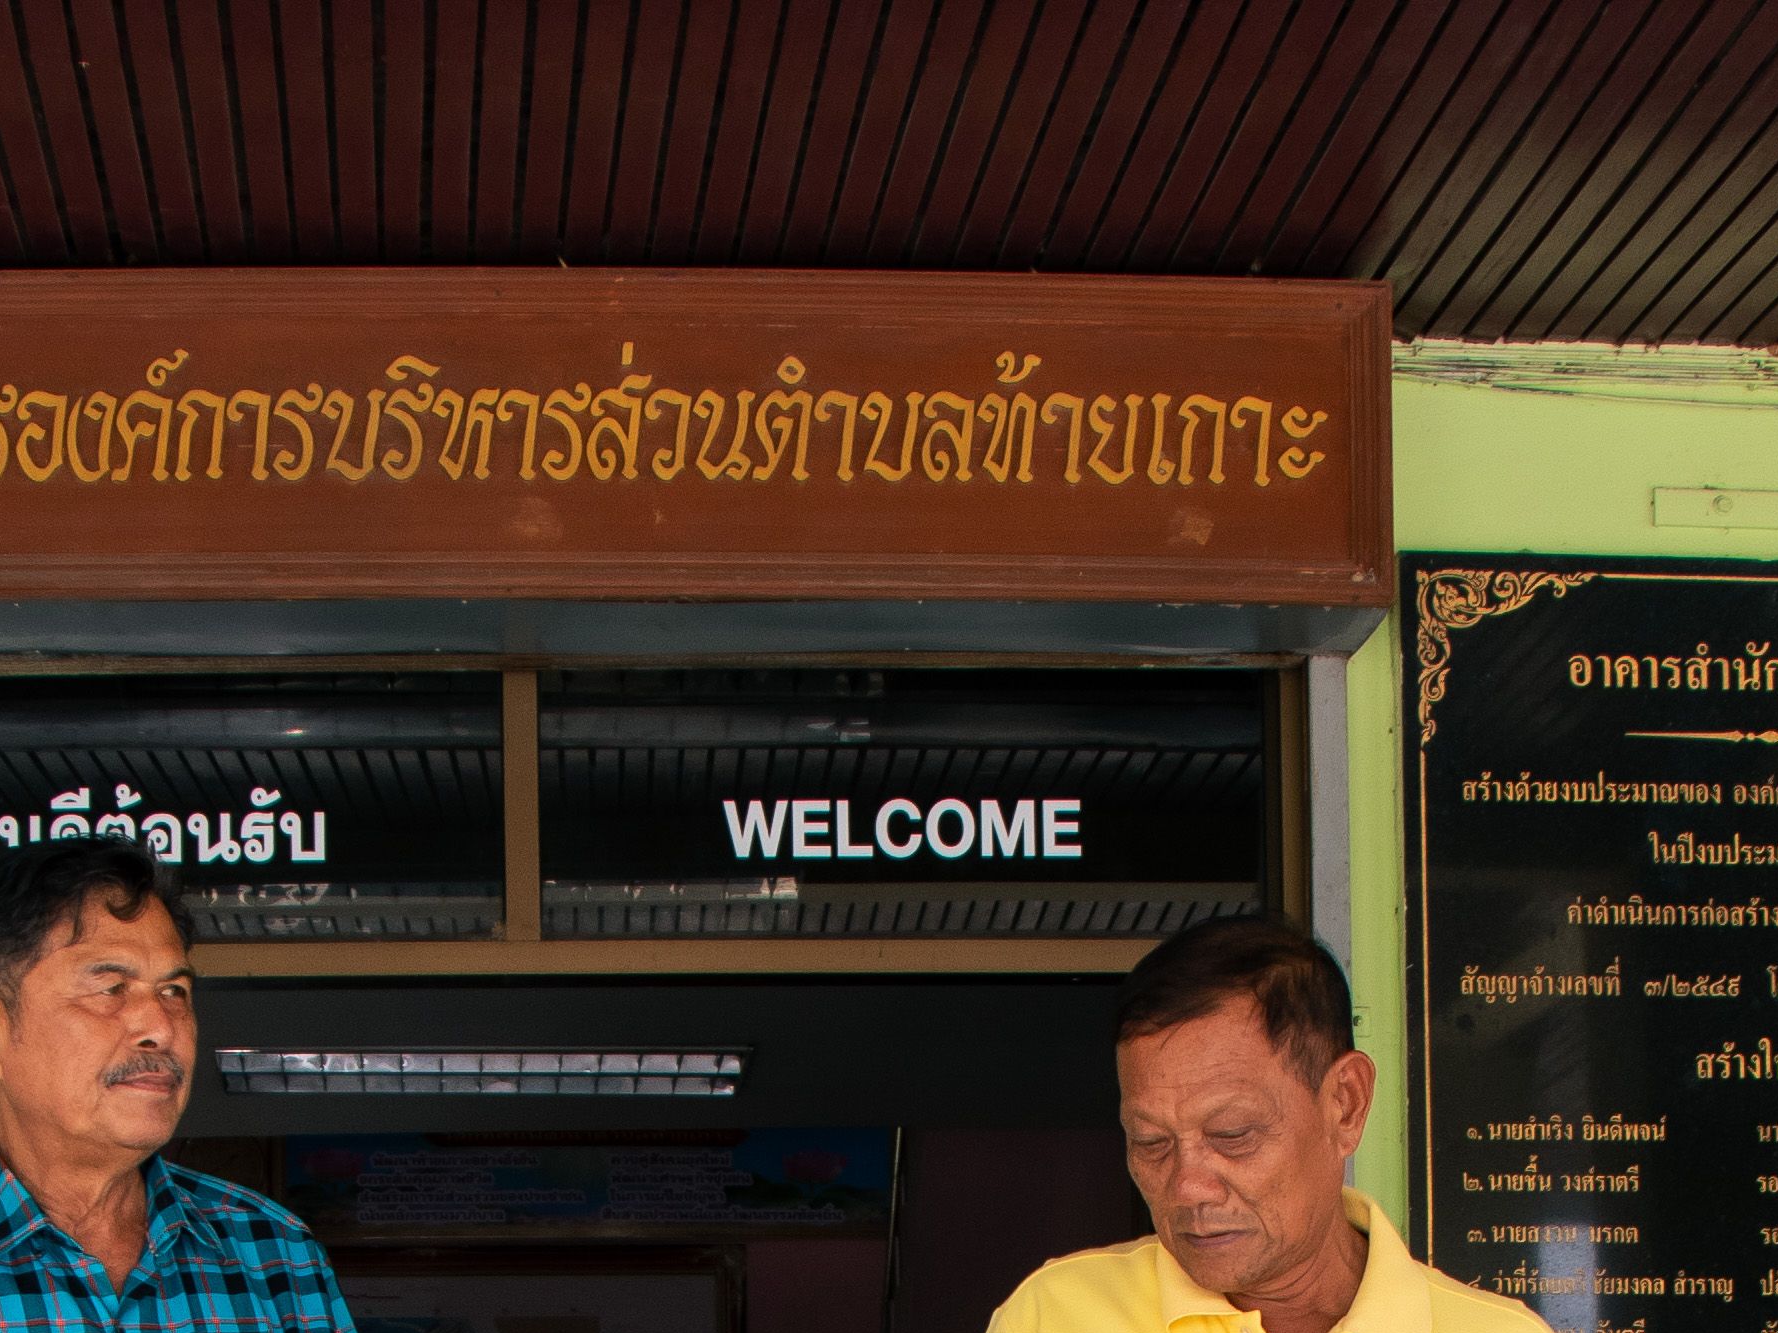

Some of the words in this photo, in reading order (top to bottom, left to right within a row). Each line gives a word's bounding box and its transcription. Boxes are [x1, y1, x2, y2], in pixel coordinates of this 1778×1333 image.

[1462, 769, 1723, 804] สร้างด้วยงบประมาณของ
[723, 797, 1084, 860] WELCOME
[1459, 956, 1622, 1005] สัญญาจ้างเลขที่
[1589, 1225, 1640, 1243] มรกต
[1674, 1269, 1735, 1302] สำราญ
